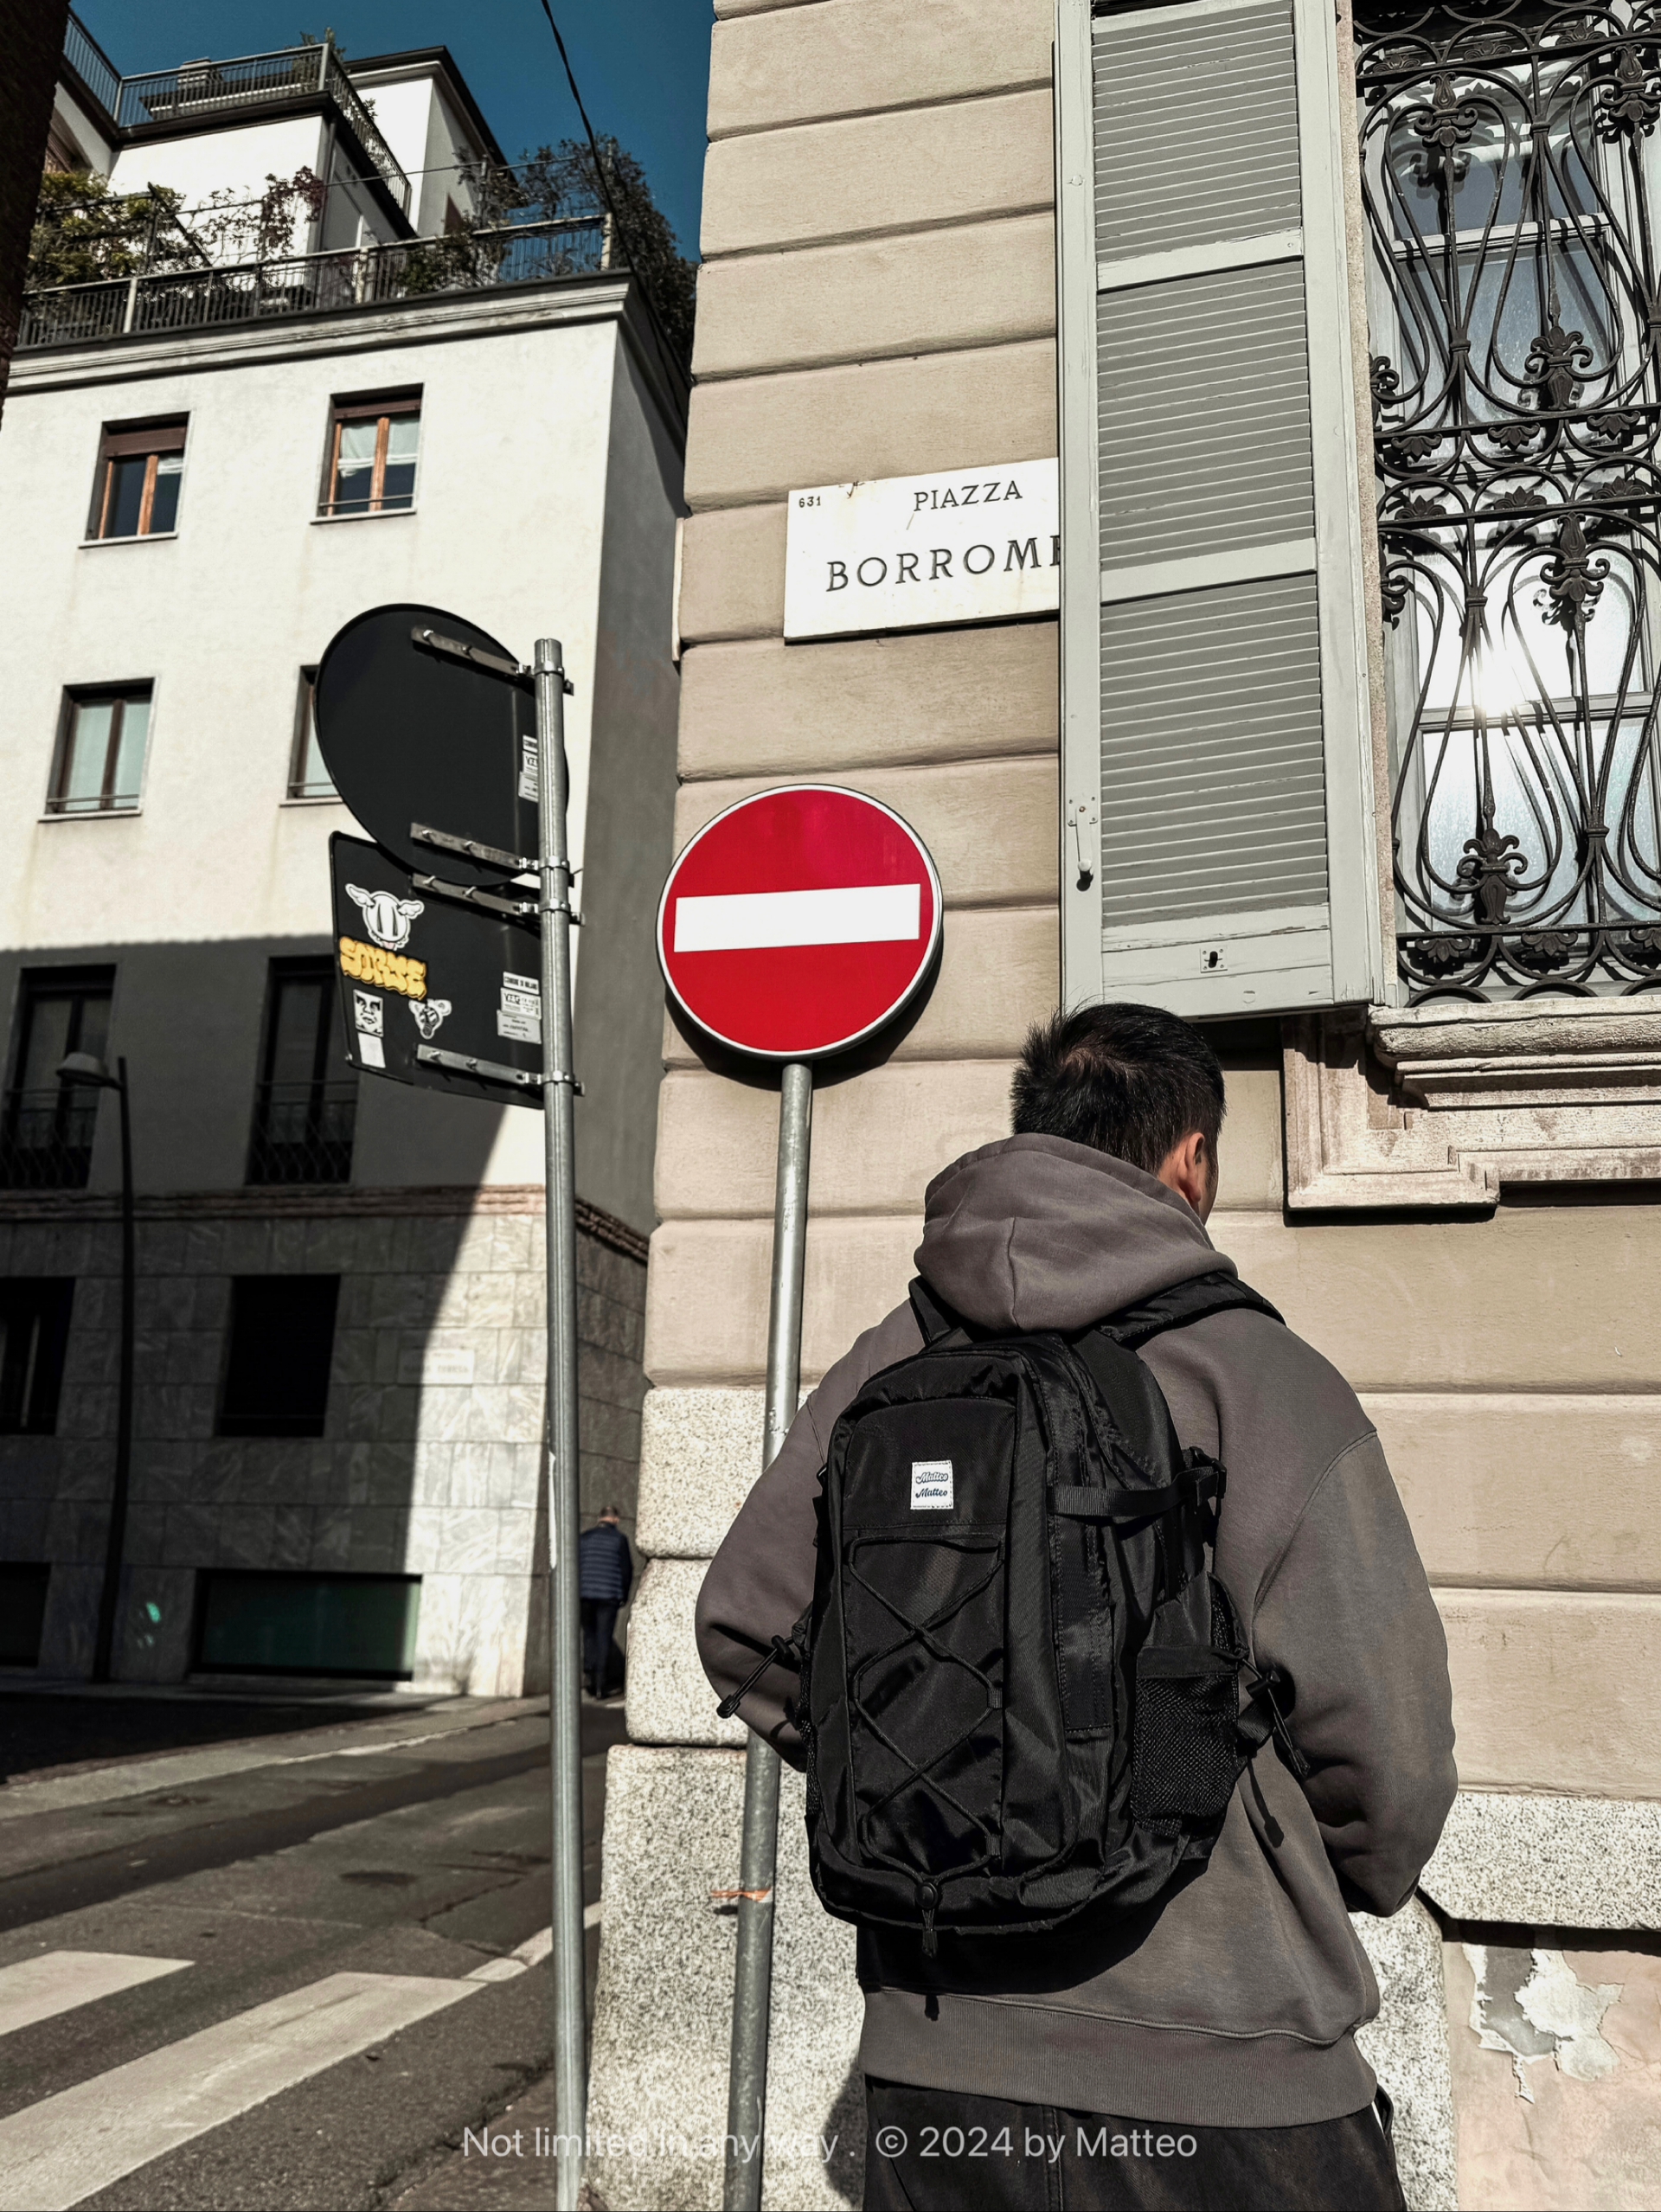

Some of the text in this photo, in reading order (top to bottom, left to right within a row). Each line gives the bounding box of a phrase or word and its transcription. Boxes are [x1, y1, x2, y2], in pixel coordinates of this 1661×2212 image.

[798, 496, 821, 508] 631
[914, 480, 1023, 512] PIAZZA
[915, 1471, 949, 1484] Matteo
[915, 1487, 948, 1498] Matteo
